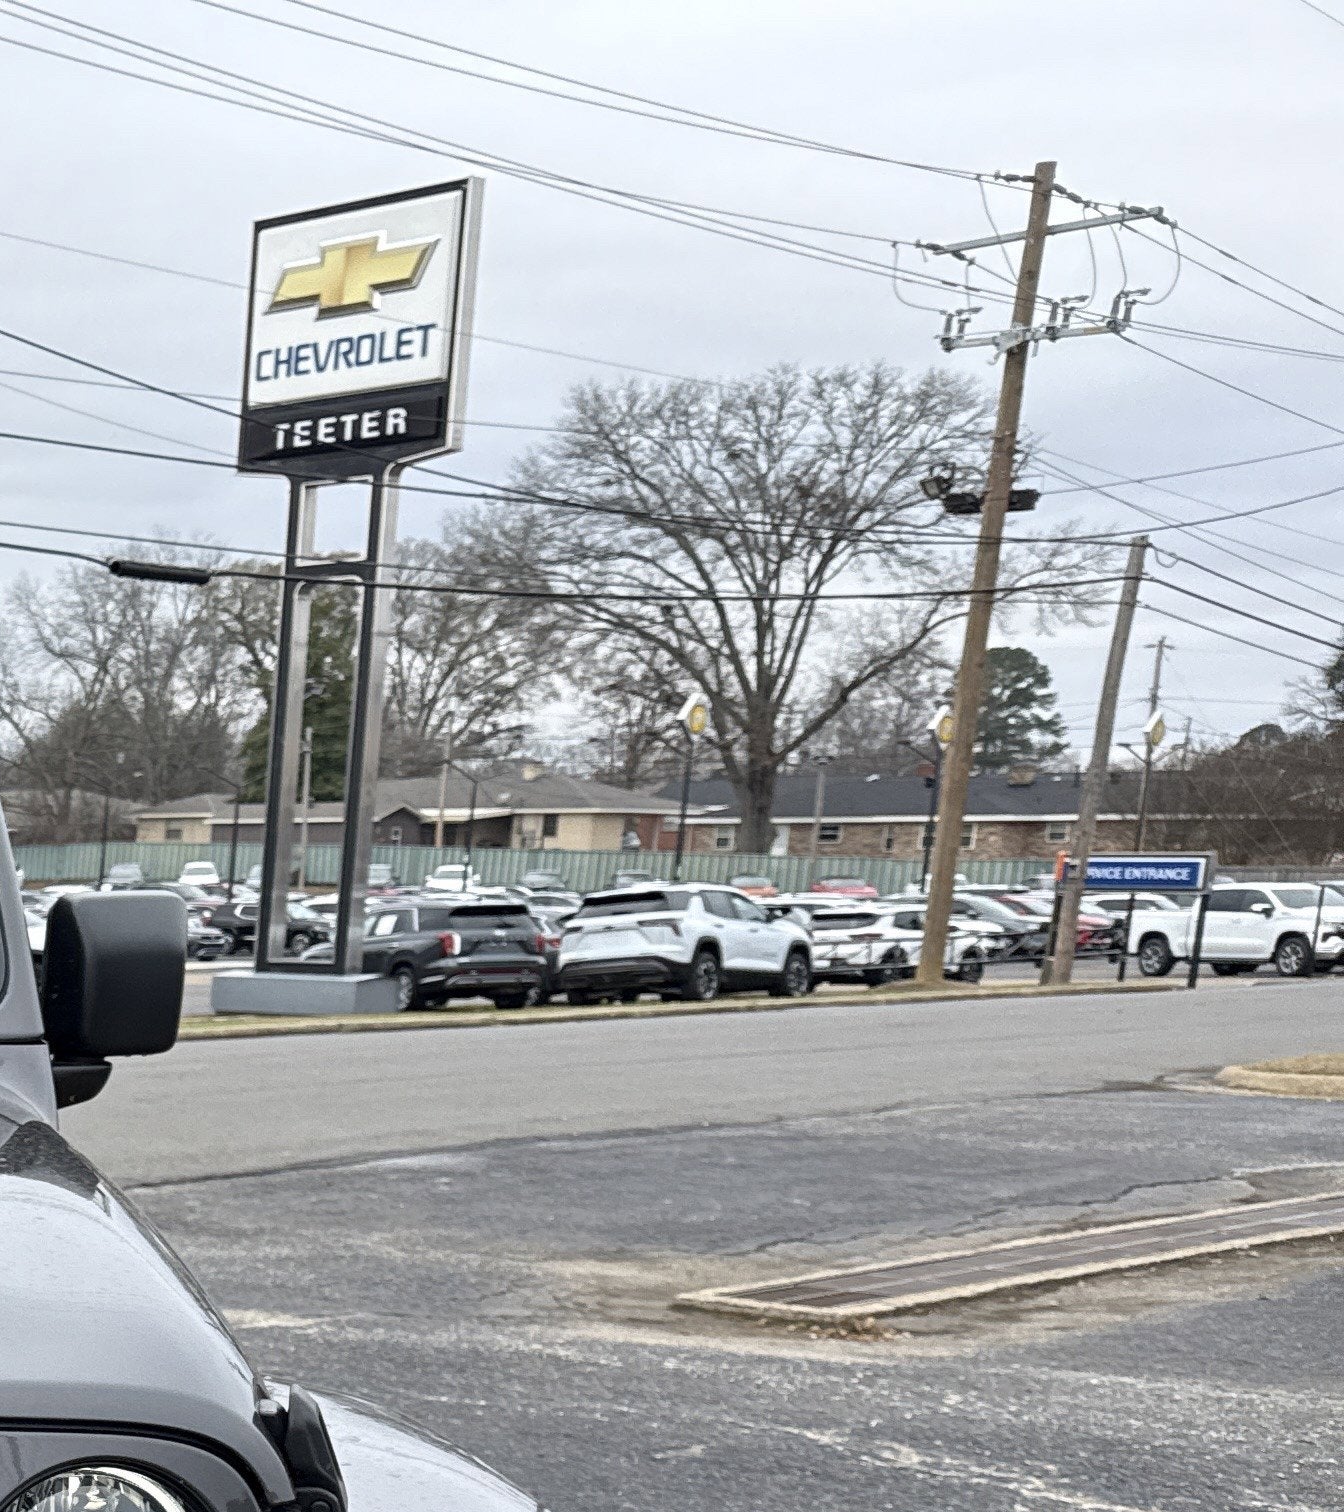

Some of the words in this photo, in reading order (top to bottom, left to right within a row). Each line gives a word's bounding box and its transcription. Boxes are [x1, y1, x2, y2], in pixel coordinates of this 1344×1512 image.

[255, 323, 438, 381] CHEVROLET
[273, 406, 409, 450] TEETER
[1127, 866, 1191, 881] ENTRANCE
